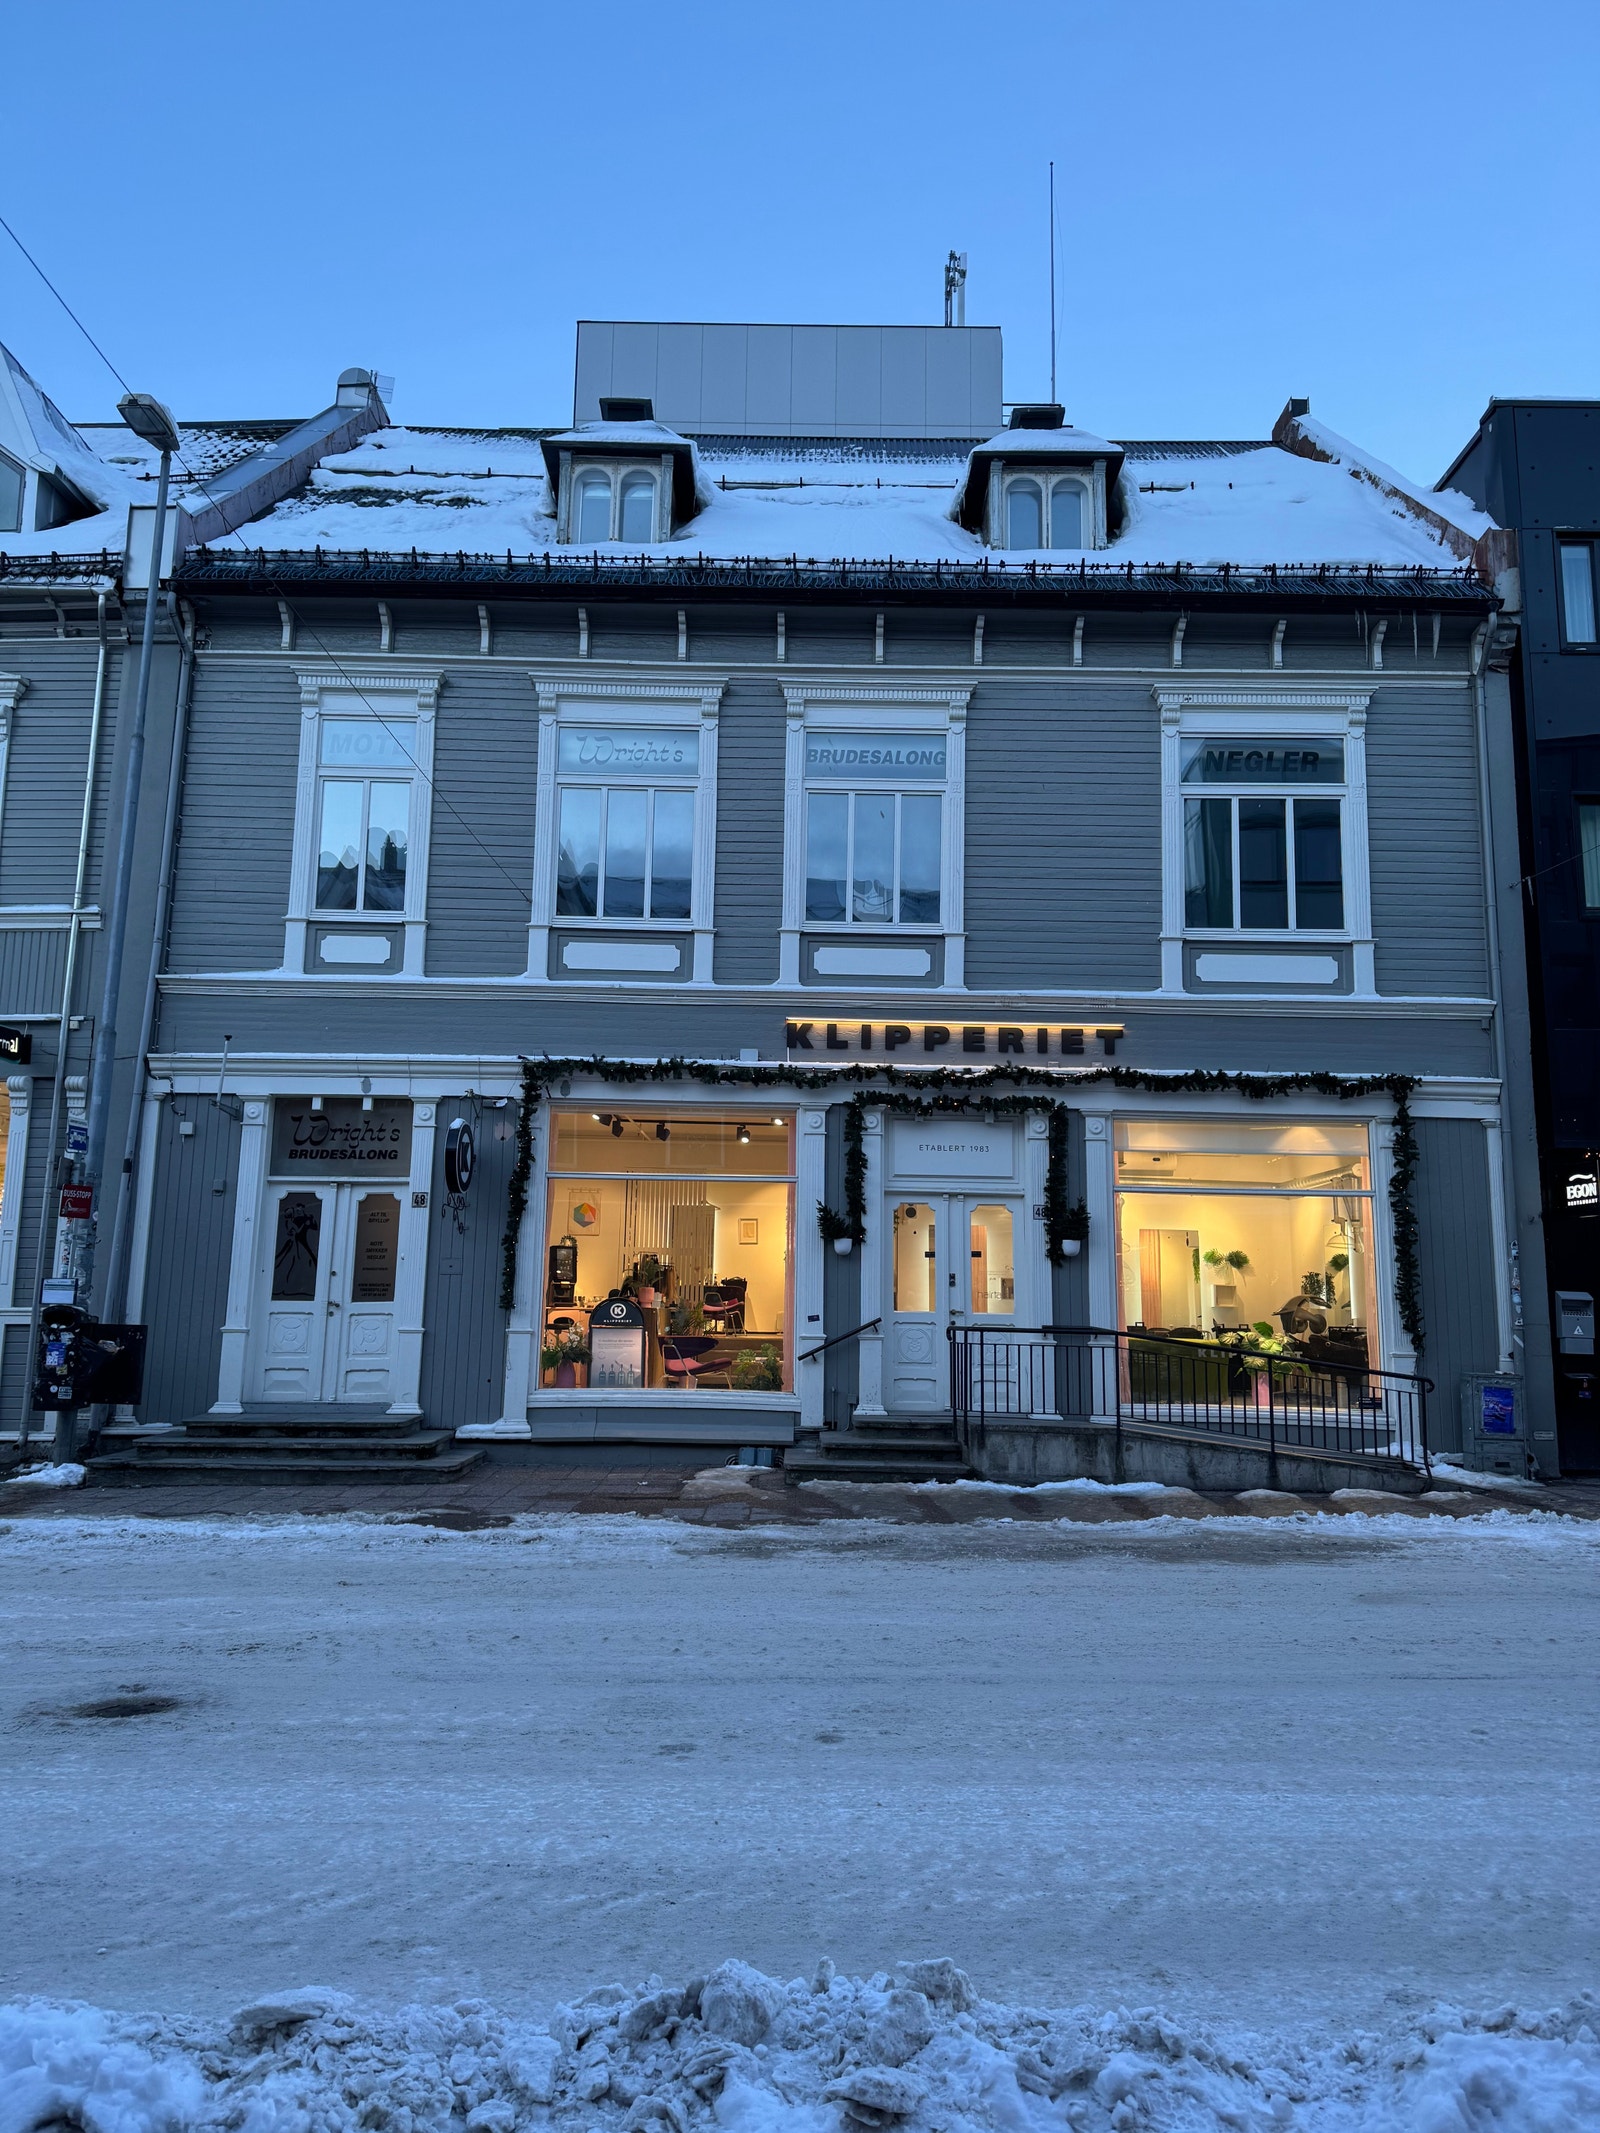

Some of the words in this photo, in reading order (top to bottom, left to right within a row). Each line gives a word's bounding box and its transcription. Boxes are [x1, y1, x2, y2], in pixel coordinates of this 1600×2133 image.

[576, 735, 684, 768] Wright's
[806, 748, 946, 766] BRUDESALONG
[1204, 750, 1320, 773] NEGLER
[786, 1022, 1124, 1056] KLIPPERIET
[290, 1115, 401, 1149] Wright's
[288, 1149, 399, 1160] BRUDESALONG
[918, 1144, 966, 1152] ETABLERT
[970, 1145, 990, 1153] 1983
[1566, 1182, 1597, 1199] EGON
[414, 1194, 426, 1206] 48
